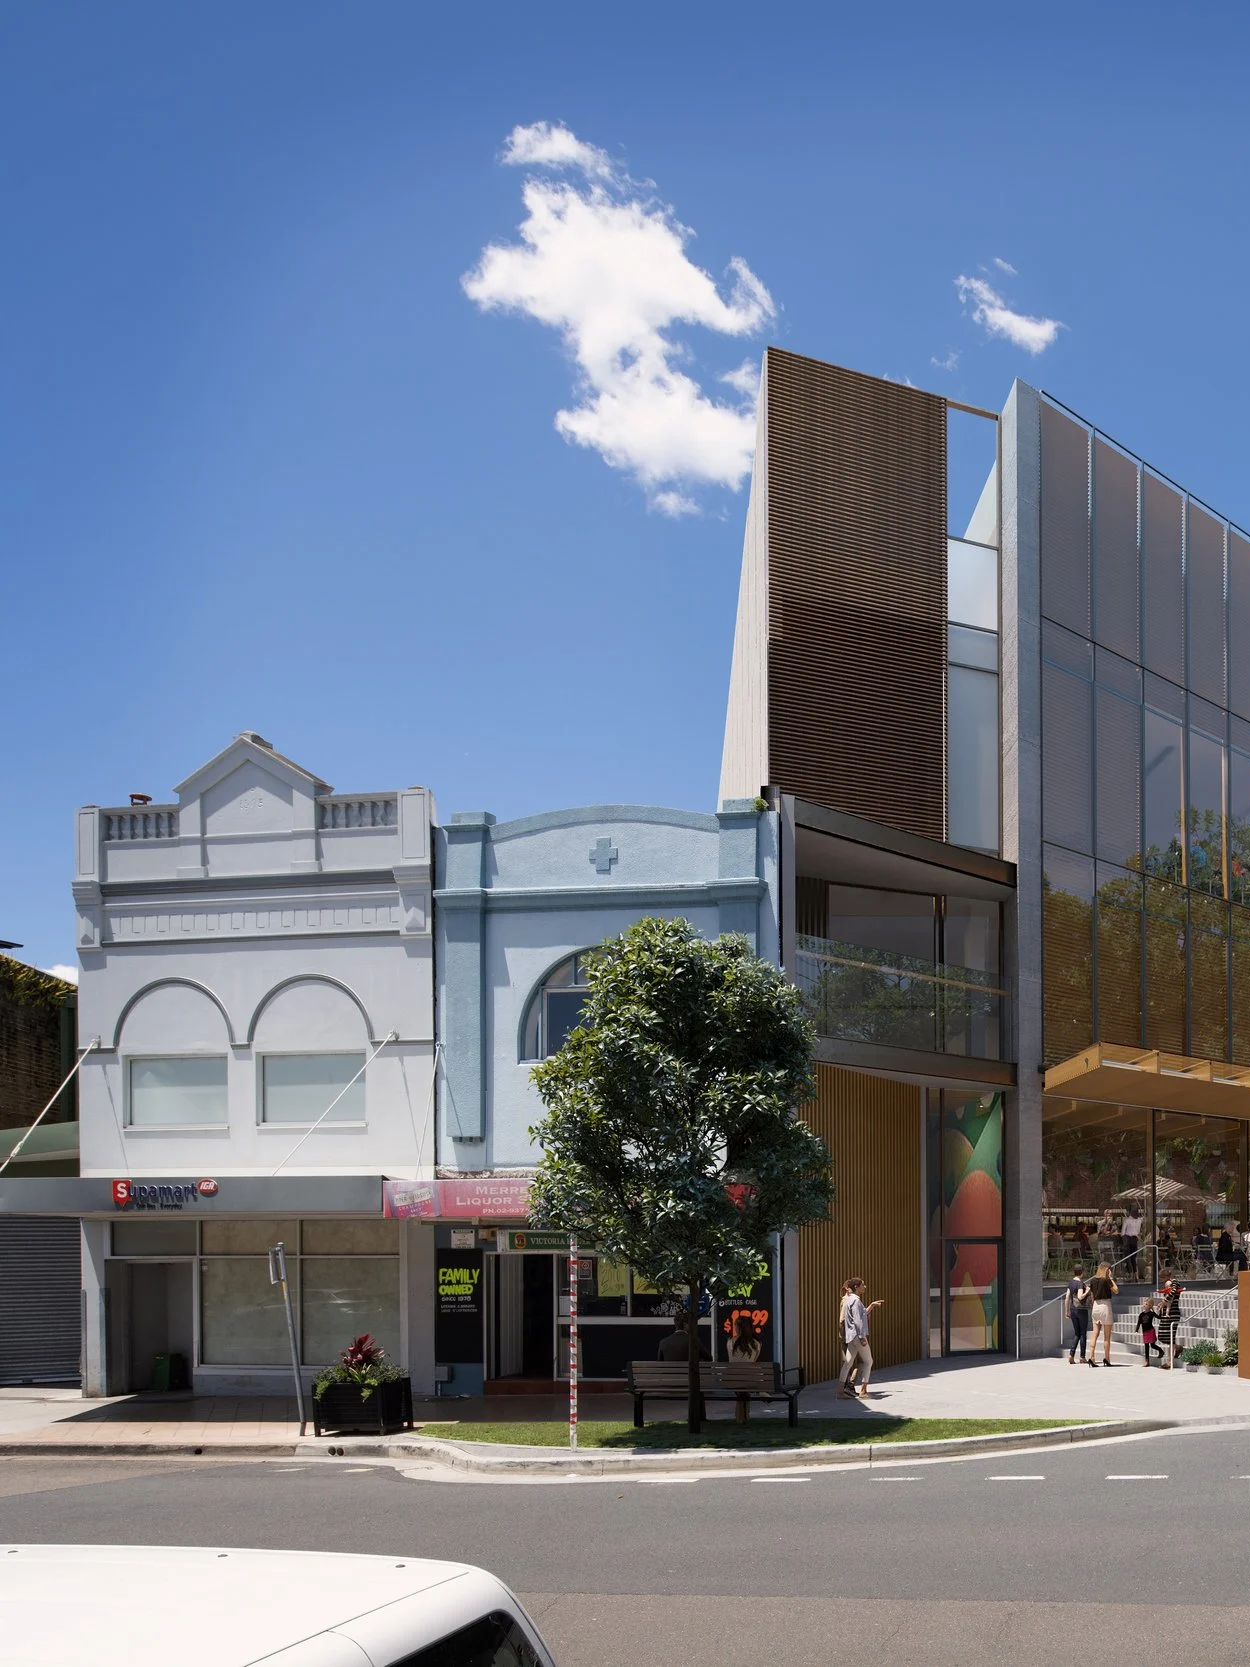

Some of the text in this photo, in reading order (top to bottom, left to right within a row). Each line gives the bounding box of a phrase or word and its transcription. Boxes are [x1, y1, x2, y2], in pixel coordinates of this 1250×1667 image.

[117, 1182, 198, 1199] Supamart
[200, 1182, 214, 1190] IGA
[456, 1197, 512, 1206] LIQUOR
[530, 1237, 565, 1245] VICTORIA
[439, 1268, 480, 1284] FAMILY
[438, 1284, 474, 1296] OWNED
